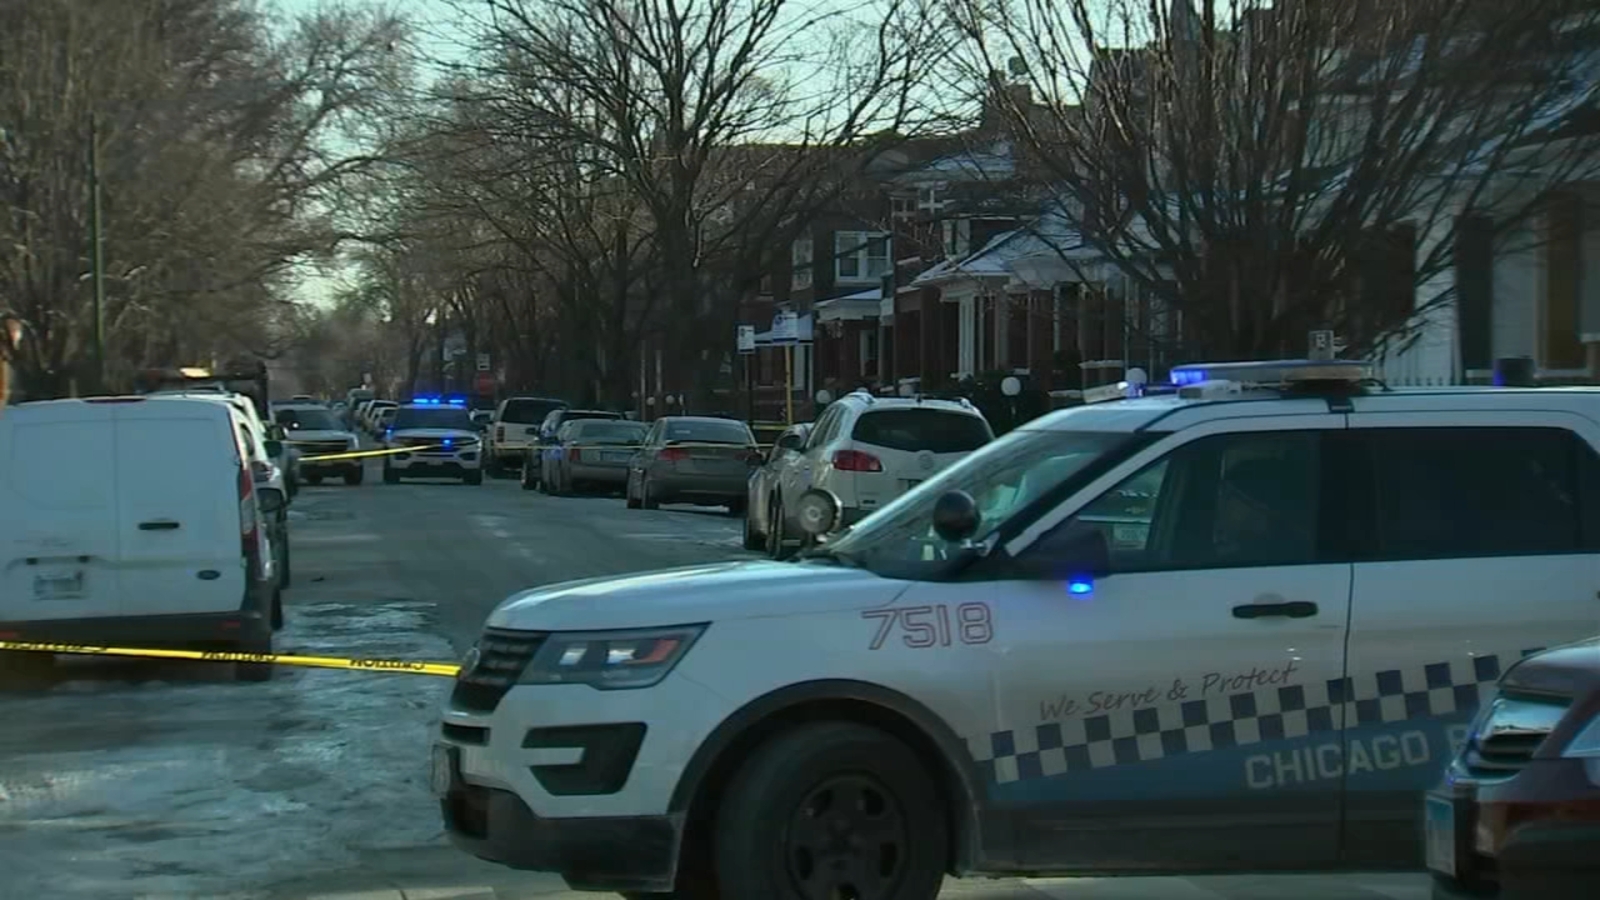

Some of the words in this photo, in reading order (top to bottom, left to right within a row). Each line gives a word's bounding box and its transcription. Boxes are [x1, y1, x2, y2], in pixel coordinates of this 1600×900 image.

[861, 601, 993, 651] 7518
[1040, 697, 1080, 721] We
[1083, 686, 1161, 715] Serve
[1167, 679, 1190, 700] &
[1202, 661, 1298, 696] Protect
[1245, 729, 1430, 789] CHICAGO
